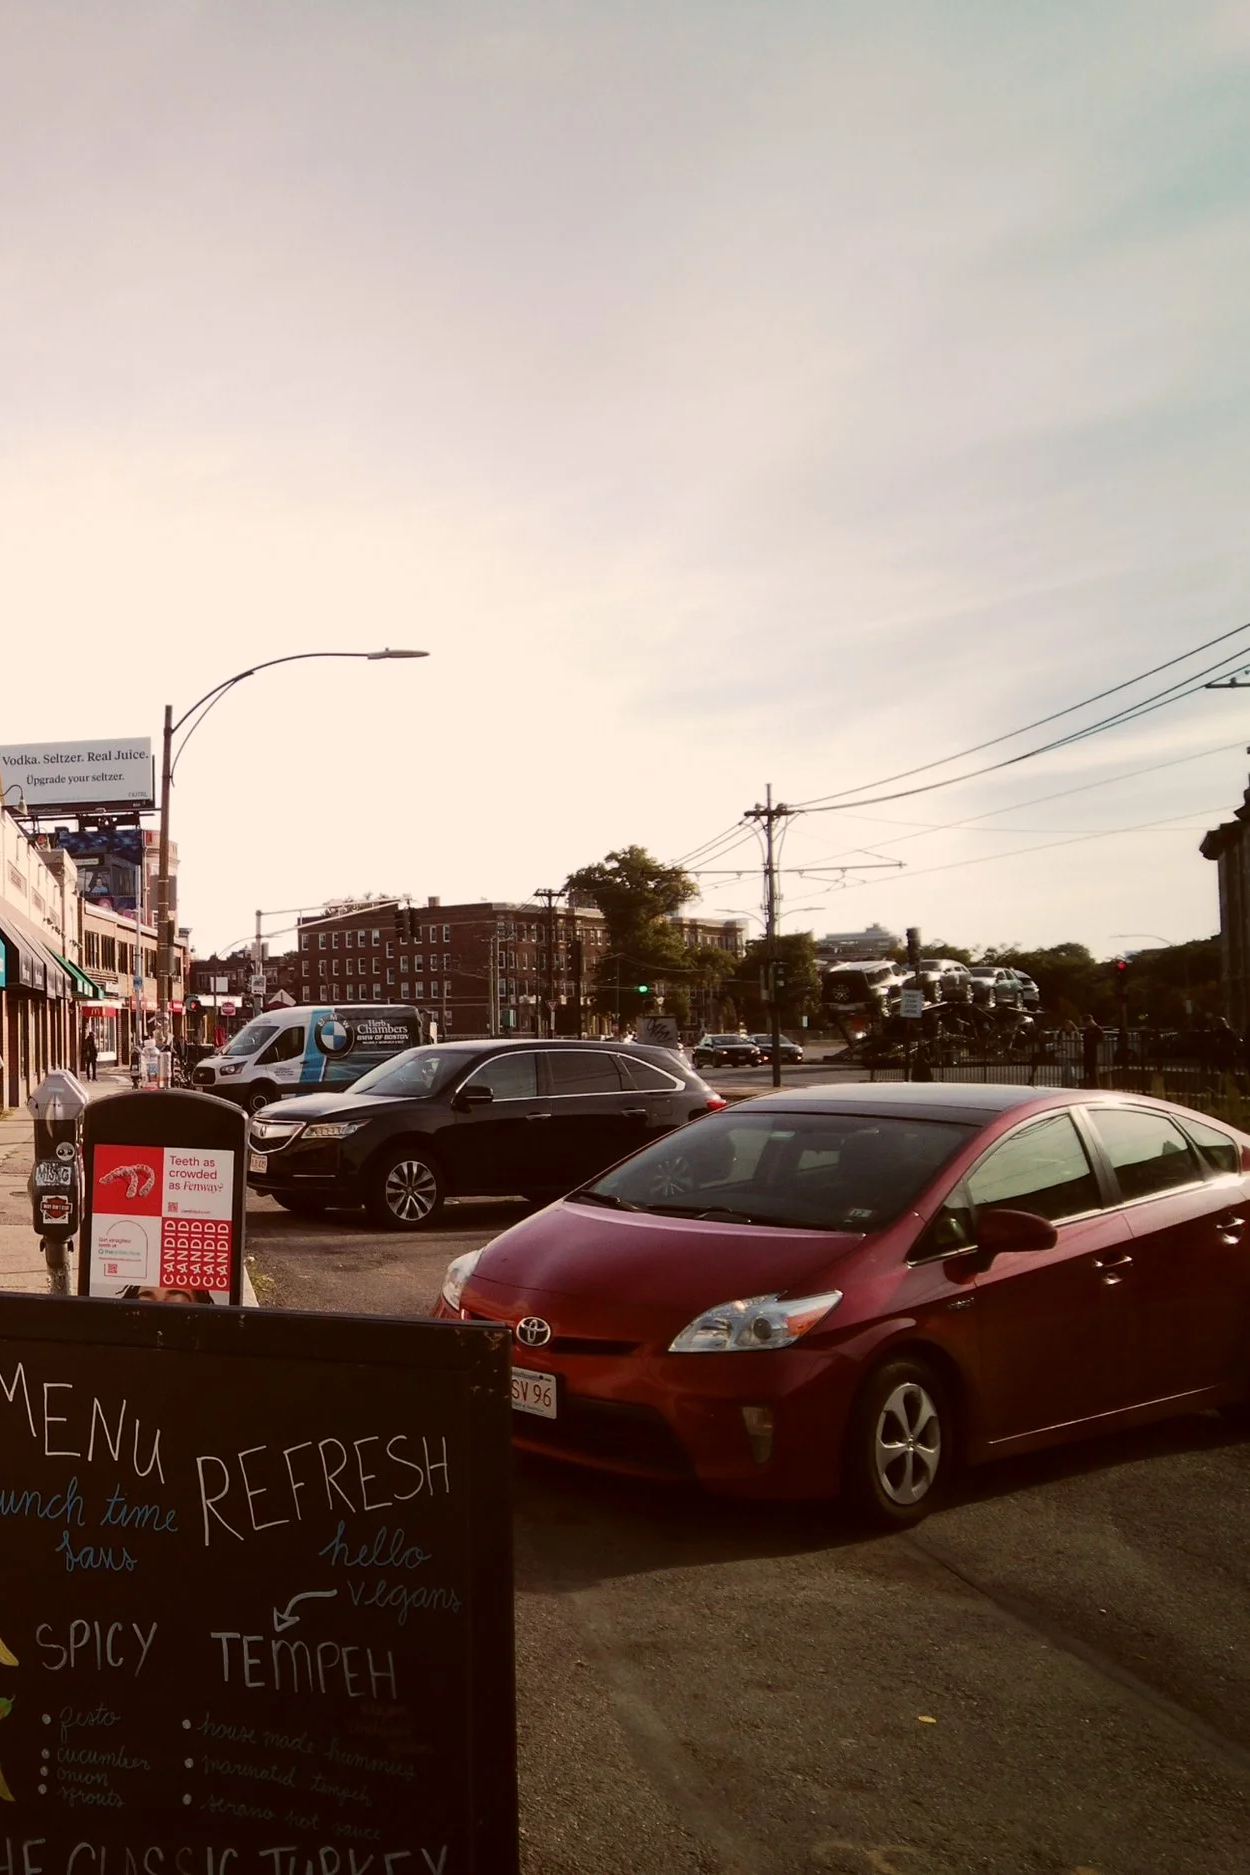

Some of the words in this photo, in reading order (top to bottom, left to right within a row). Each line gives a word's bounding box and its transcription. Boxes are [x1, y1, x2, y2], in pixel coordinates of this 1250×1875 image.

[2, 755, 41, 766] Vodka.
[43, 753, 84, 764] Seltzer.
[87, 751, 112, 762] Real
[114, 749, 149, 761] Juice.
[68, 776, 89, 785] your
[91, 772, 125, 782] seltzer.
[357, 1023, 408, 1034] Chambers
[368, 1019, 386, 1027] Herb
[168, 1169, 218, 1180] crowded
[169, 1155, 200, 1167] Teeth
[203, 1159, 215, 1167] as
[168, 1182, 181, 1190] as
[183, 1181, 224, 1193] Fenway?
[163, 1220, 176, 1285] CANDID
[176, 1221, 189, 1286] CANDID
[189, 1222, 203, 1287] CANDID
[202, 1222, 216, 1287] CANDID
[216, 1223, 229, 1288] CANDID
[533, 1384, 552, 1407] 96
[99, 1482, 180, 1533] time
[196, 1434, 450, 1547] REFRESH
[317, 1519, 433, 1570] hello
[346, 1579, 463, 1627] vegans
[35, 1618, 159, 1678] SPICY
[210, 1631, 398, 1700] TEMPEH
[58, 1703, 122, 1744] pesto
[56, 1745, 151, 1772] cucumber
[197, 1711, 258, 1745] house
[262, 1730, 316, 1755] made
[322, 1737, 418, 1782] hummus
[56, 1784, 126, 1808] sprouts
[57, 1766, 110, 1787] onion
[310, 1771, 374, 1808] tempeh
[284, 1808, 321, 1832] hot
[329, 1818, 382, 1842] sauce
